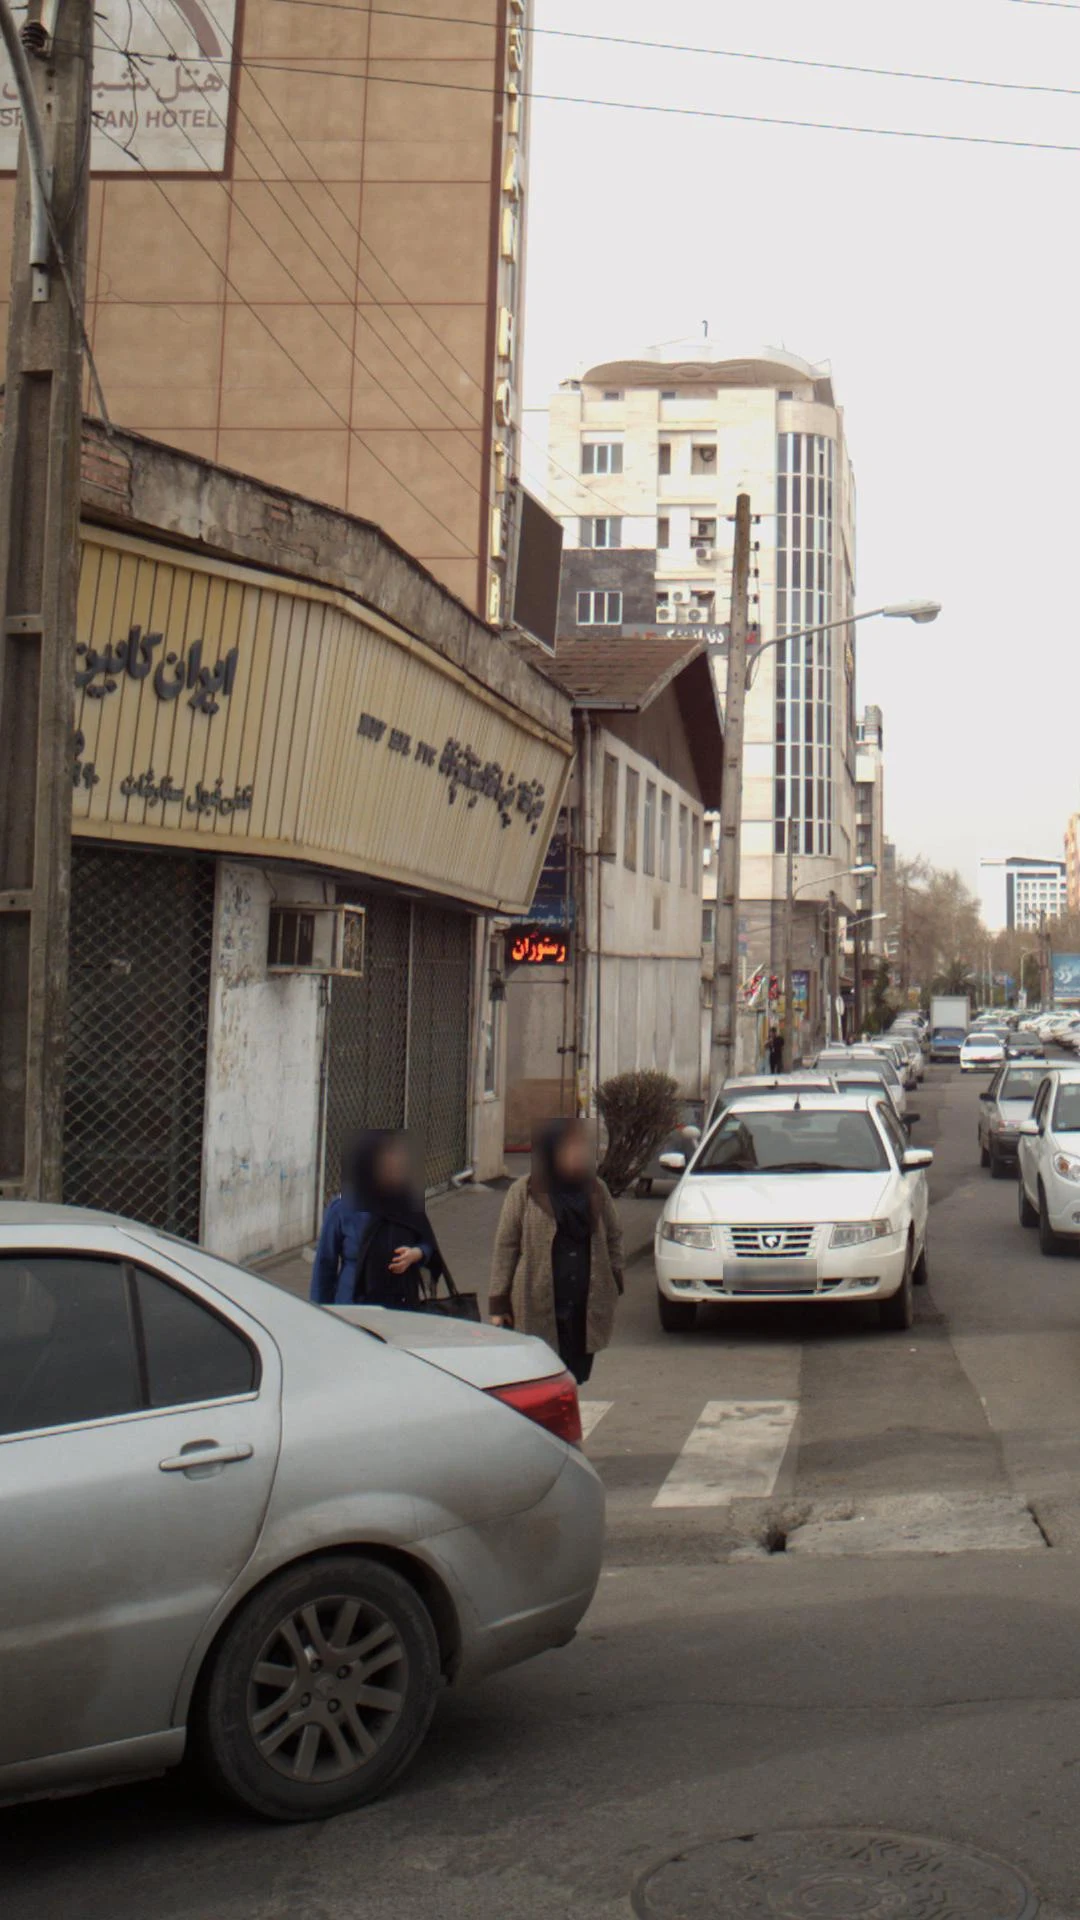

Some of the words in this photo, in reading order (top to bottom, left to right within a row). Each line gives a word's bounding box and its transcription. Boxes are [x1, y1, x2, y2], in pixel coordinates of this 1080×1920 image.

[156, 66, 223, 104] هتل
[146, 110, 218, 128] HOTEL
[154, 640, 239, 715] ایران
[511, 936, 566, 963] رستوران
